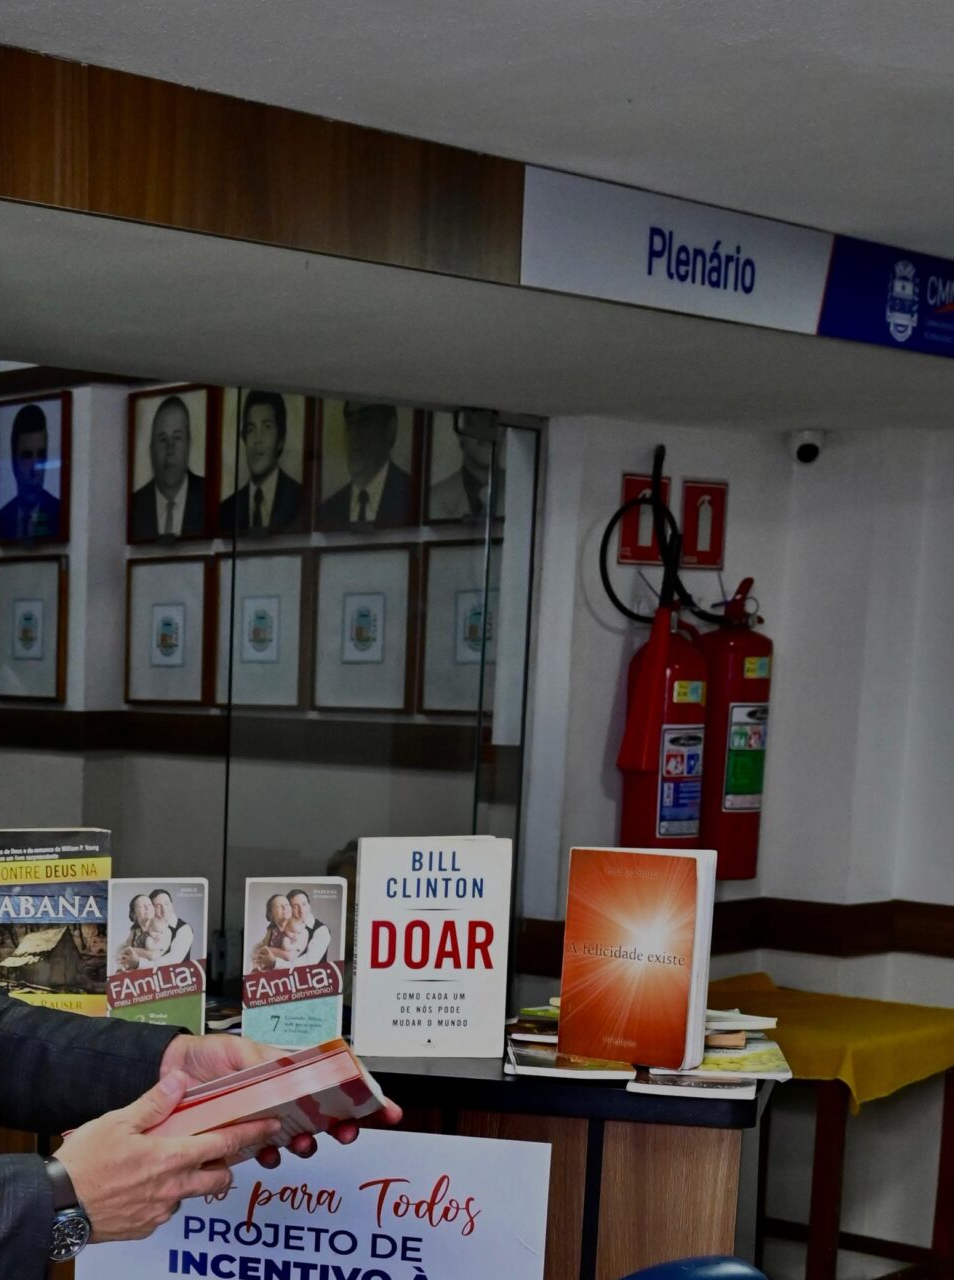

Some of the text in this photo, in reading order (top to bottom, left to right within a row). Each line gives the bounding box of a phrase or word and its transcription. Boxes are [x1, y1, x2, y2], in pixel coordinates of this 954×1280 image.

[647, 226, 756, 294] Plenário
[46, 864, 77, 879] DEUS
[81, 863, 97, 876] NA
[411, 851, 461, 872] BILL
[386, 877, 484, 899] CLINTON
[369, 919, 494, 970] DOAR
[567, 942, 686, 967] A felicidade existe
[114, 999, 131, 1007] meu
[133, 993, 154, 1004] maior
[249, 999, 267, 1007] meu
[268, 993, 290, 1005] maior
[396, 992, 466, 1001] COMO CADA UM
[400, 1003, 461, 1014] DE NÓS PODE
[270, 1015, 281, 1032] 7
[392, 1018, 468, 1027] MUDAR O MUNDO
[246, 1174, 481, 1236] para Todos
[183, 1215, 423, 1263] PROJETO DE
